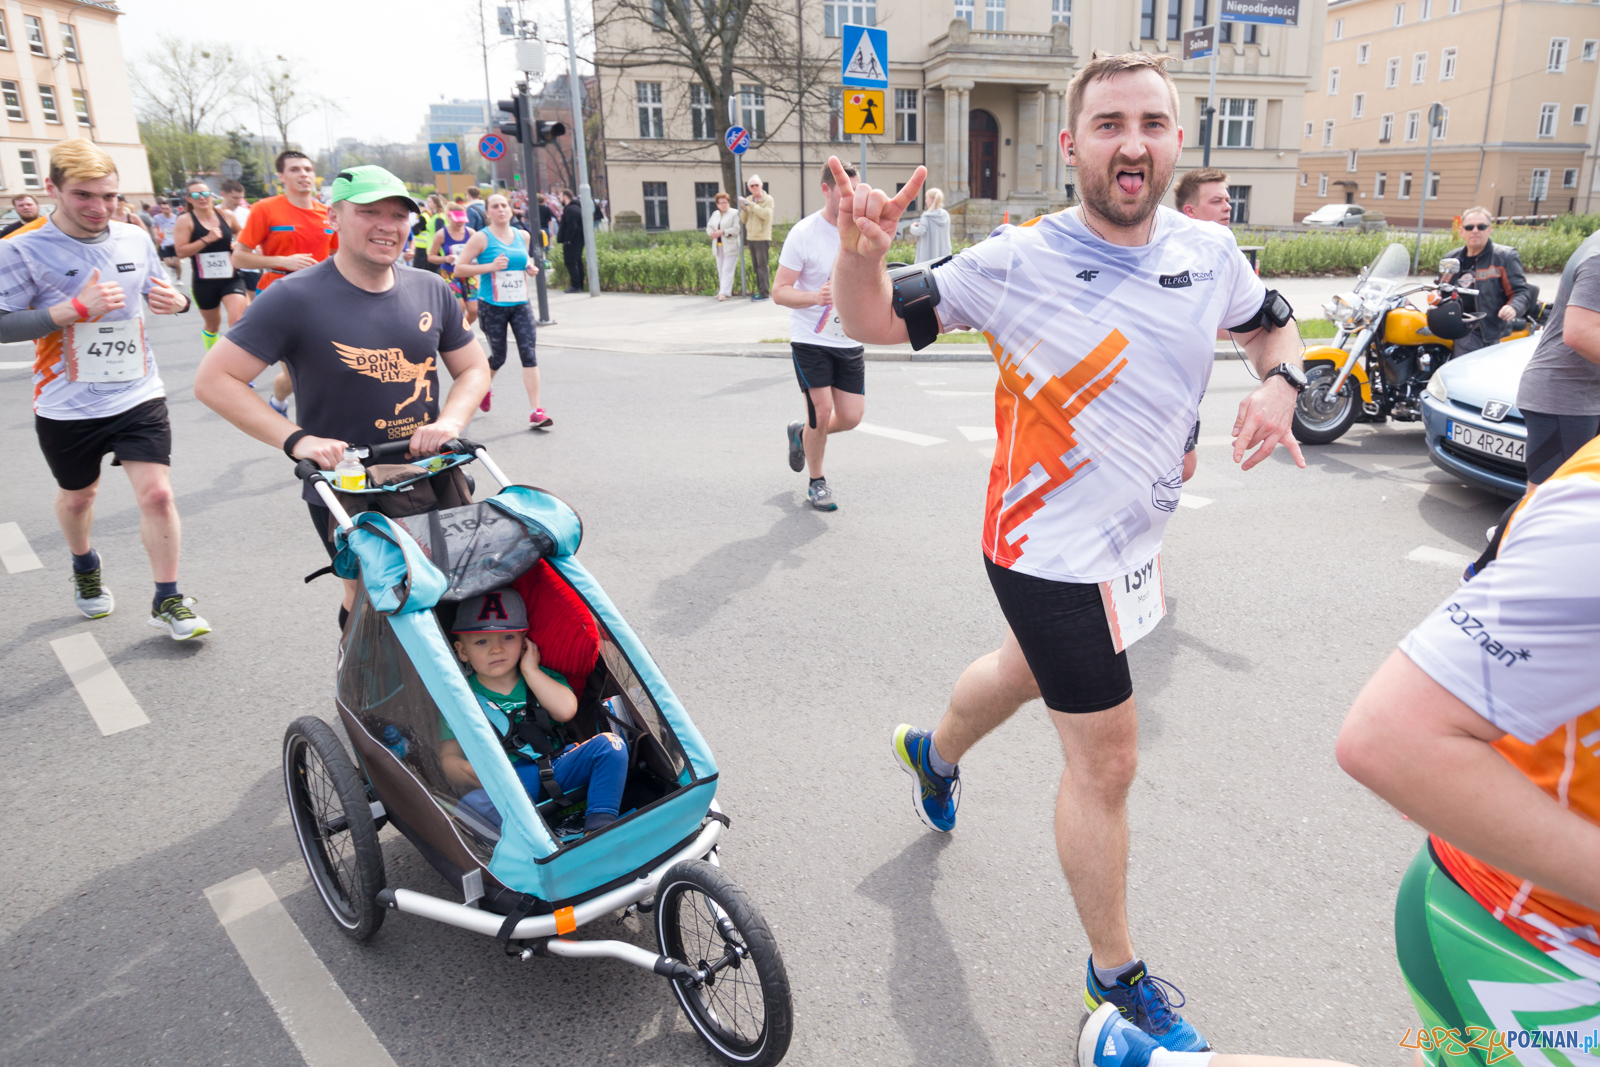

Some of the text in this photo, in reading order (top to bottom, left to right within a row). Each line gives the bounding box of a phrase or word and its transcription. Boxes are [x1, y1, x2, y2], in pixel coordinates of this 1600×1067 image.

[1226, 0, 1296, 17] Niepodległości
[1190, 38, 1208, 50] Solna
[206, 260, 227, 268] 3621
[1075, 269, 1100, 282] 4F
[501, 280, 523, 288] 4437
[87, 339, 137, 357] 4796
[356, 351, 401, 366] DON'T
[369, 361, 399, 374] RUN
[381, 370, 401, 382] FLY
[387, 416, 415, 427] ZURICH
[1454, 424, 1525, 461] PO 4R244
[477, 592, 508, 621] A
